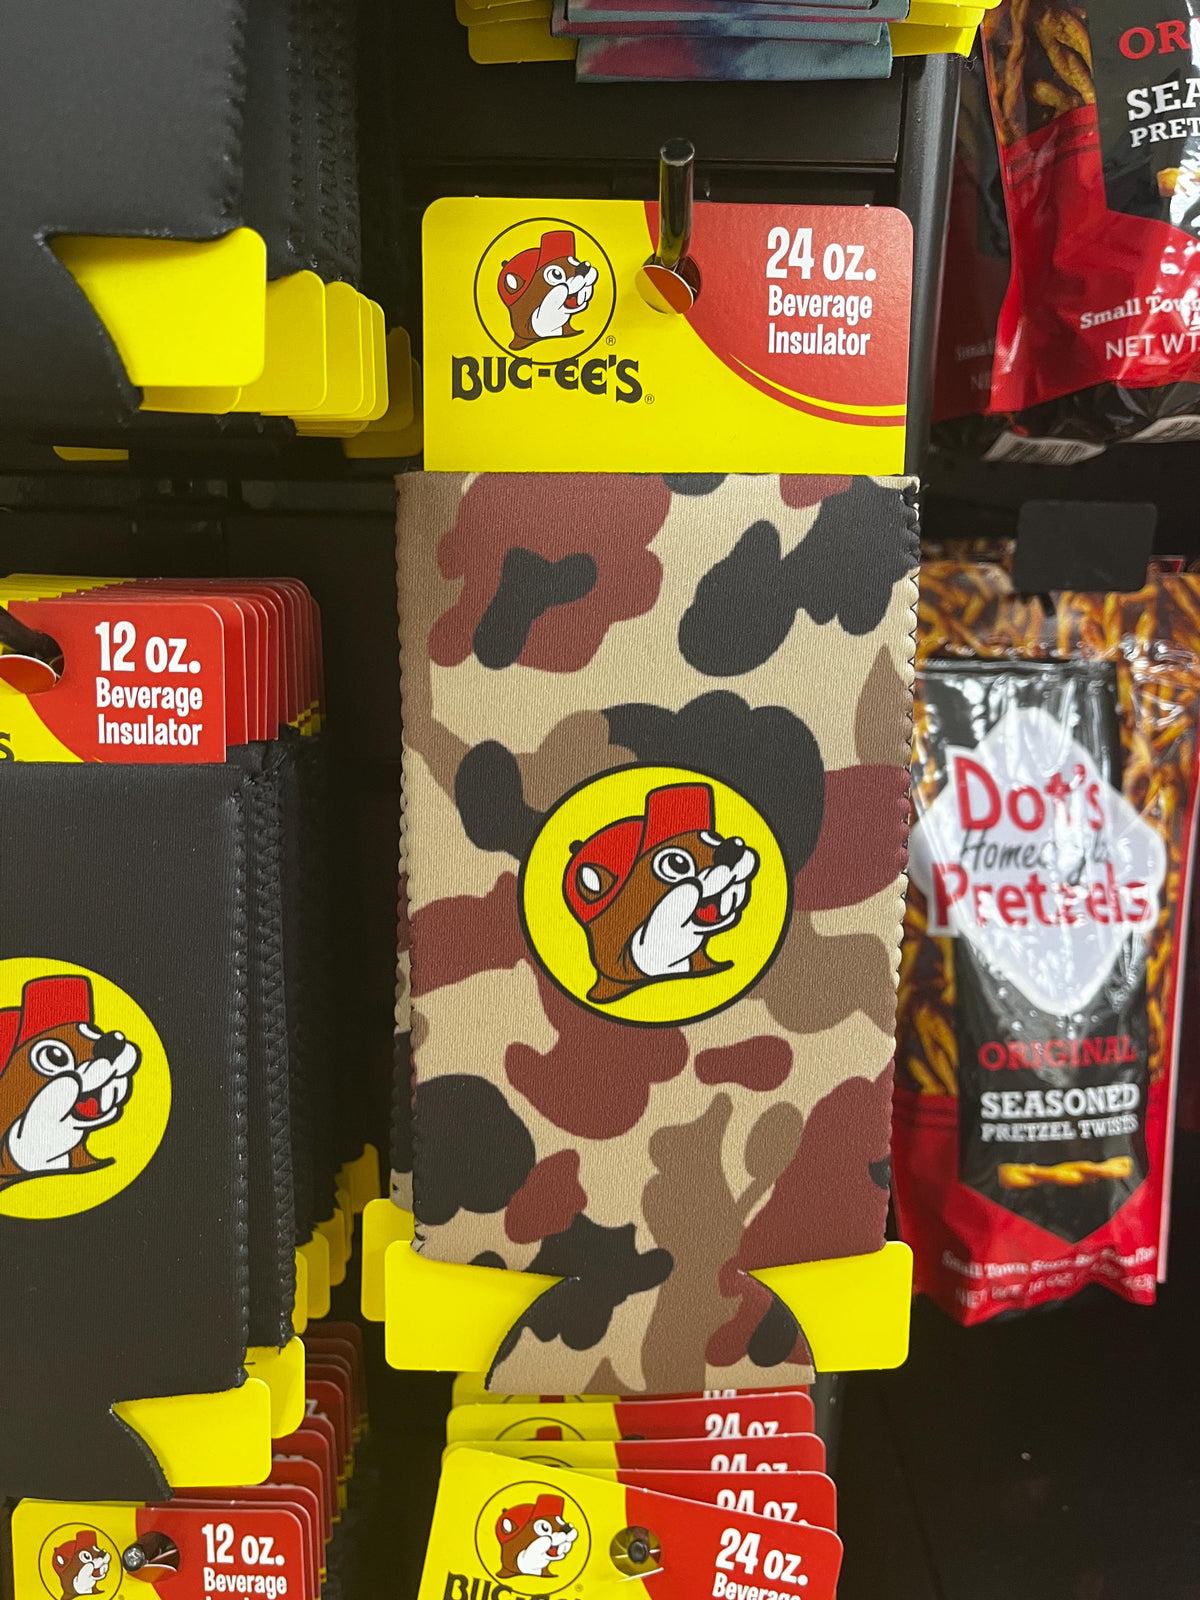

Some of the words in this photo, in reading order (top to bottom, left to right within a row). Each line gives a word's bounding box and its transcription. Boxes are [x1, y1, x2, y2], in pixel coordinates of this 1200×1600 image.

[1119, 20, 1198, 59] OR
[766, 226, 815, 280] 24
[822, 243, 877, 282] oz.
[768, 284, 873, 326] Beverage
[1080, 297, 1142, 330] Small
[768, 322, 871, 356] Insulator
[1106, 334, 1156, 361] NET
[95, 621, 136, 672] 12
[145, 636, 201, 674] oz.
[95, 676, 203, 717] Beverage
[98, 713, 203, 746] Insulator
[954, 756, 1107, 832] Dot's
[932, 862, 1151, 928] Pretzels
[978, 1035, 1138, 1071] ORIGINAL
[980, 1083, 1140, 1119] SEASONED
[980, 1120, 1077, 1142] PRETZEL
[1077, 1113, 1139, 1139] TWISTS
[201, 1522, 234, 1564] 12
[241, 1535, 285, 1567] oz.
[715, 1528, 761, 1576] 24
[763, 1549, 809, 1586] oz.
[203, 1566, 287, 1600] Beverage
[712, 1572, 801, 1600] Bevera
